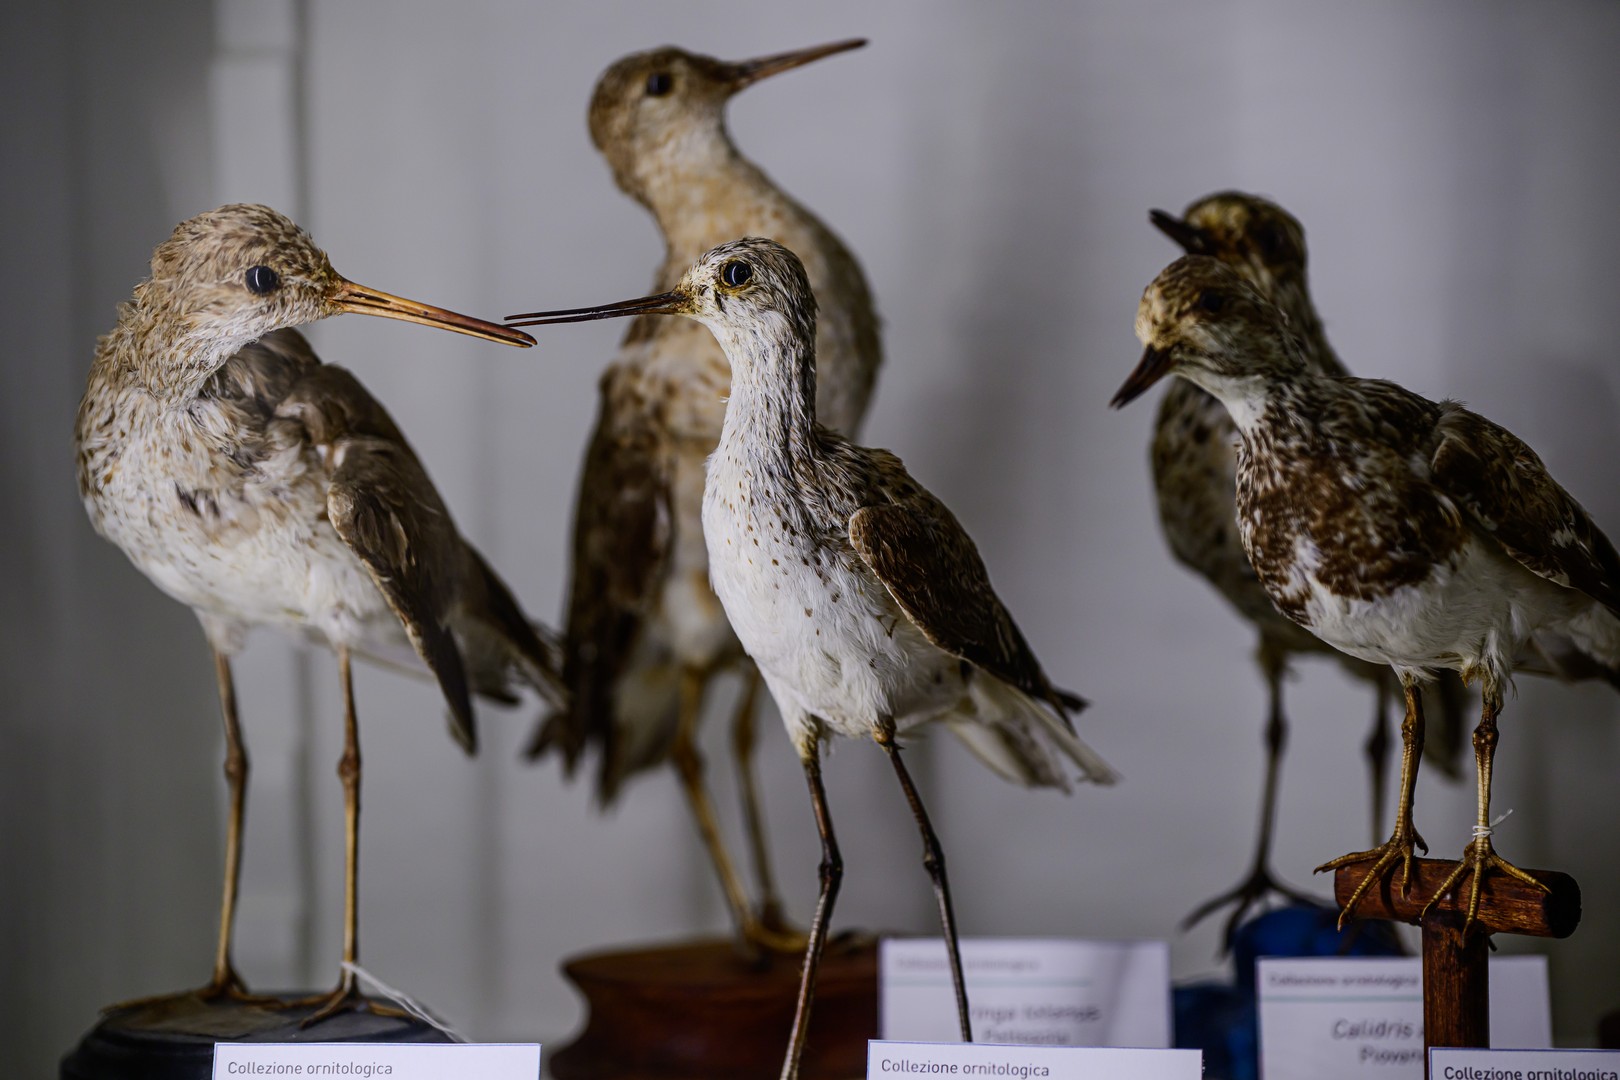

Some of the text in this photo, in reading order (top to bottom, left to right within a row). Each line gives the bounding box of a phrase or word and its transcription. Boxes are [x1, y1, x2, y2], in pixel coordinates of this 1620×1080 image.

[1332, 1018, 1414, 1040] Calidris
[227, 1061, 393, 1079] Collezione ornitologica
[881, 1058, 1050, 1080] Collezione ornitologica
[1444, 1066, 1618, 1080] Collezione ornitologica
